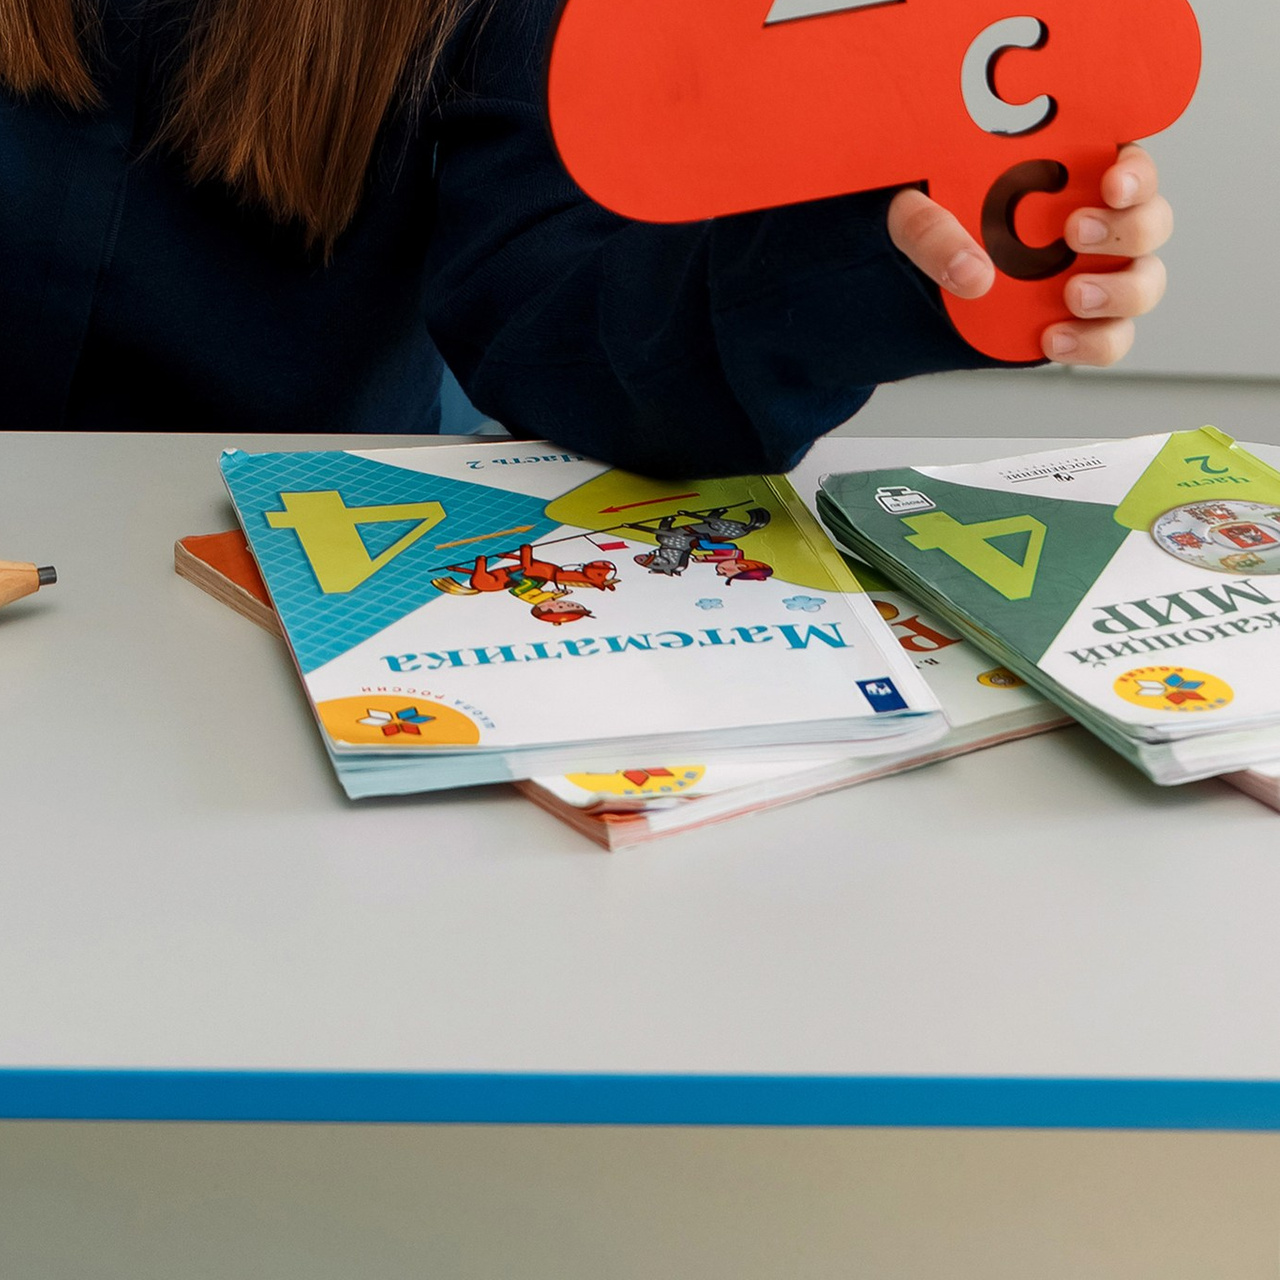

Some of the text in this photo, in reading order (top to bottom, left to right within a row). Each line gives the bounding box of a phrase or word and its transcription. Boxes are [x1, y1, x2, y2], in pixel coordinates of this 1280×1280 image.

[466, 460, 485, 470] 2
[1176, 476, 1251, 488] Часть
[1184, 455, 1229, 474] 2
[267, 490, 446, 595] 4
[900, 510, 1048, 601] 4
[1091, 578, 1280, 634] МИР
[380, 622, 854, 673] Математика
